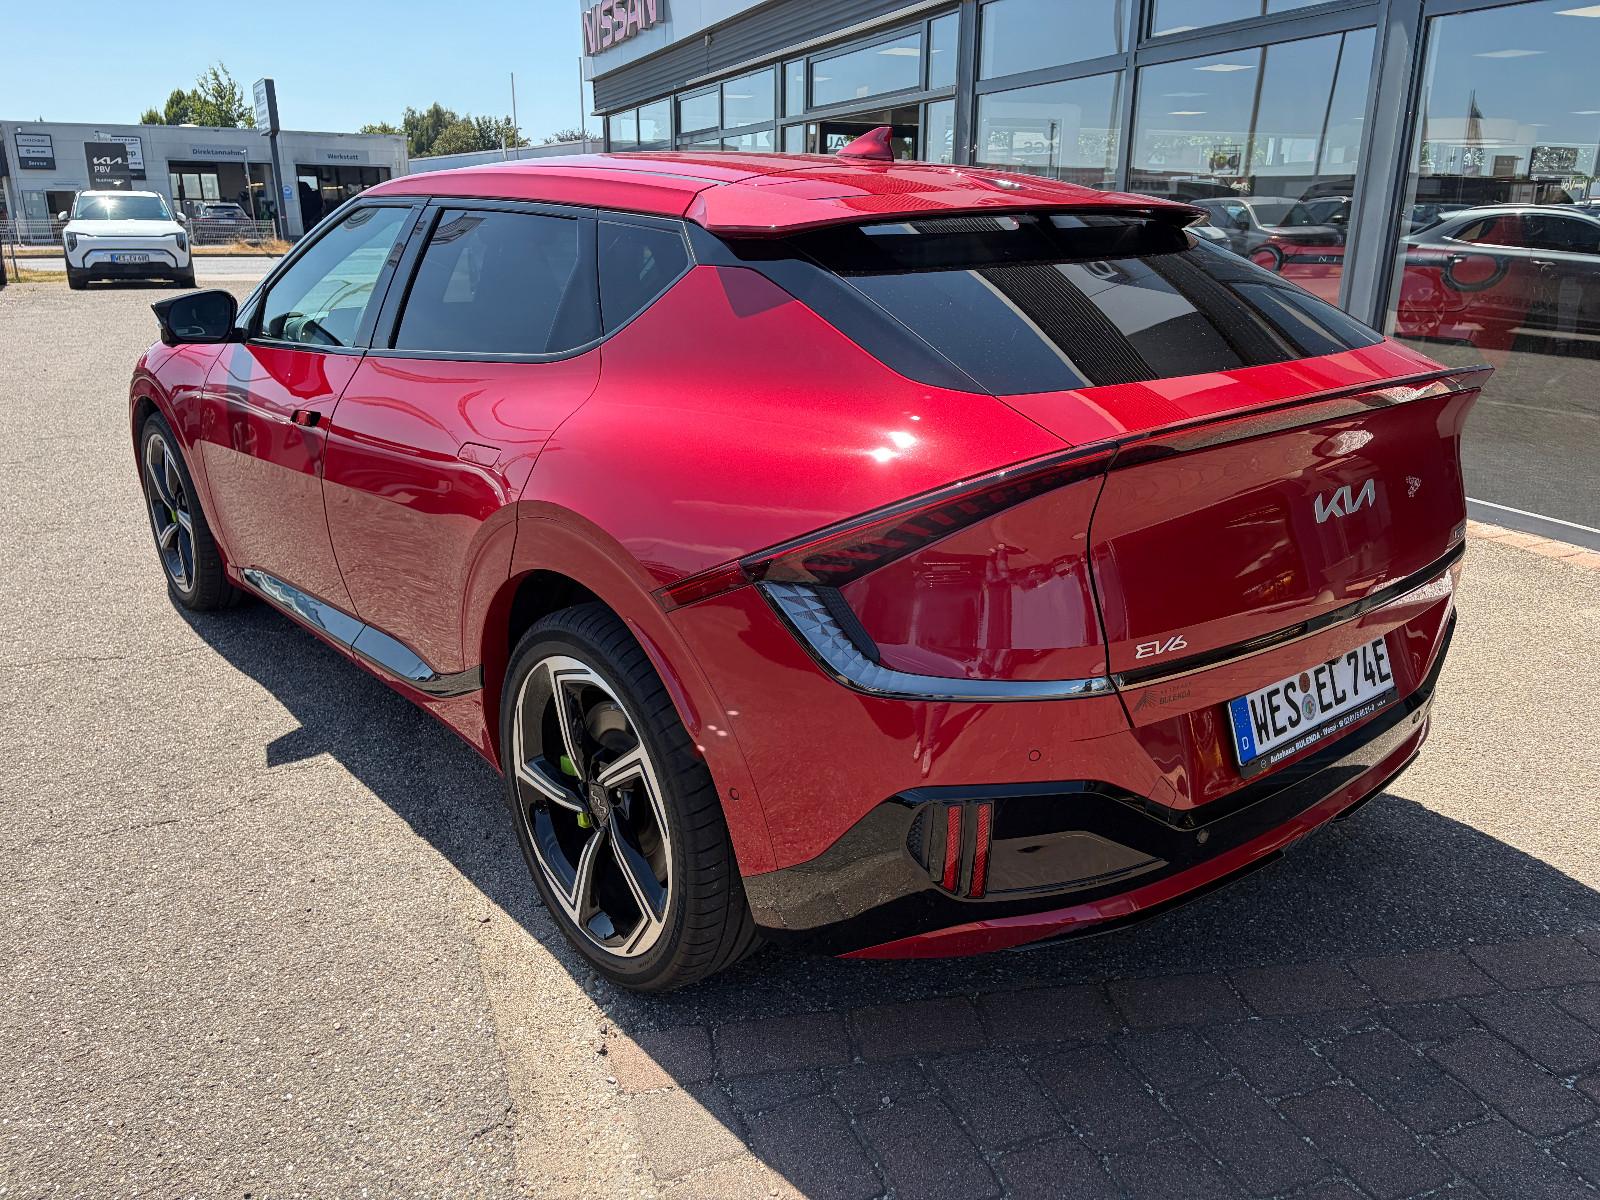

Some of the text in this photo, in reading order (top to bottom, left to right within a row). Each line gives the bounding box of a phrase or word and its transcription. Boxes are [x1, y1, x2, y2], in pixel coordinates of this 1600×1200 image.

[93, 156, 122, 165] KIA
[327, 153, 359, 161] Werkstatt
[94, 165, 111, 173] PBV
[1315, 479, 1375, 523] KIA
[1136, 635, 1188, 659] EV6
[1250, 681, 1301, 746] WES
[1346, 638, 1391, 696] 74E
[1242, 736, 1249, 751] D
[1270, 746, 1296, 763] Autohaus
